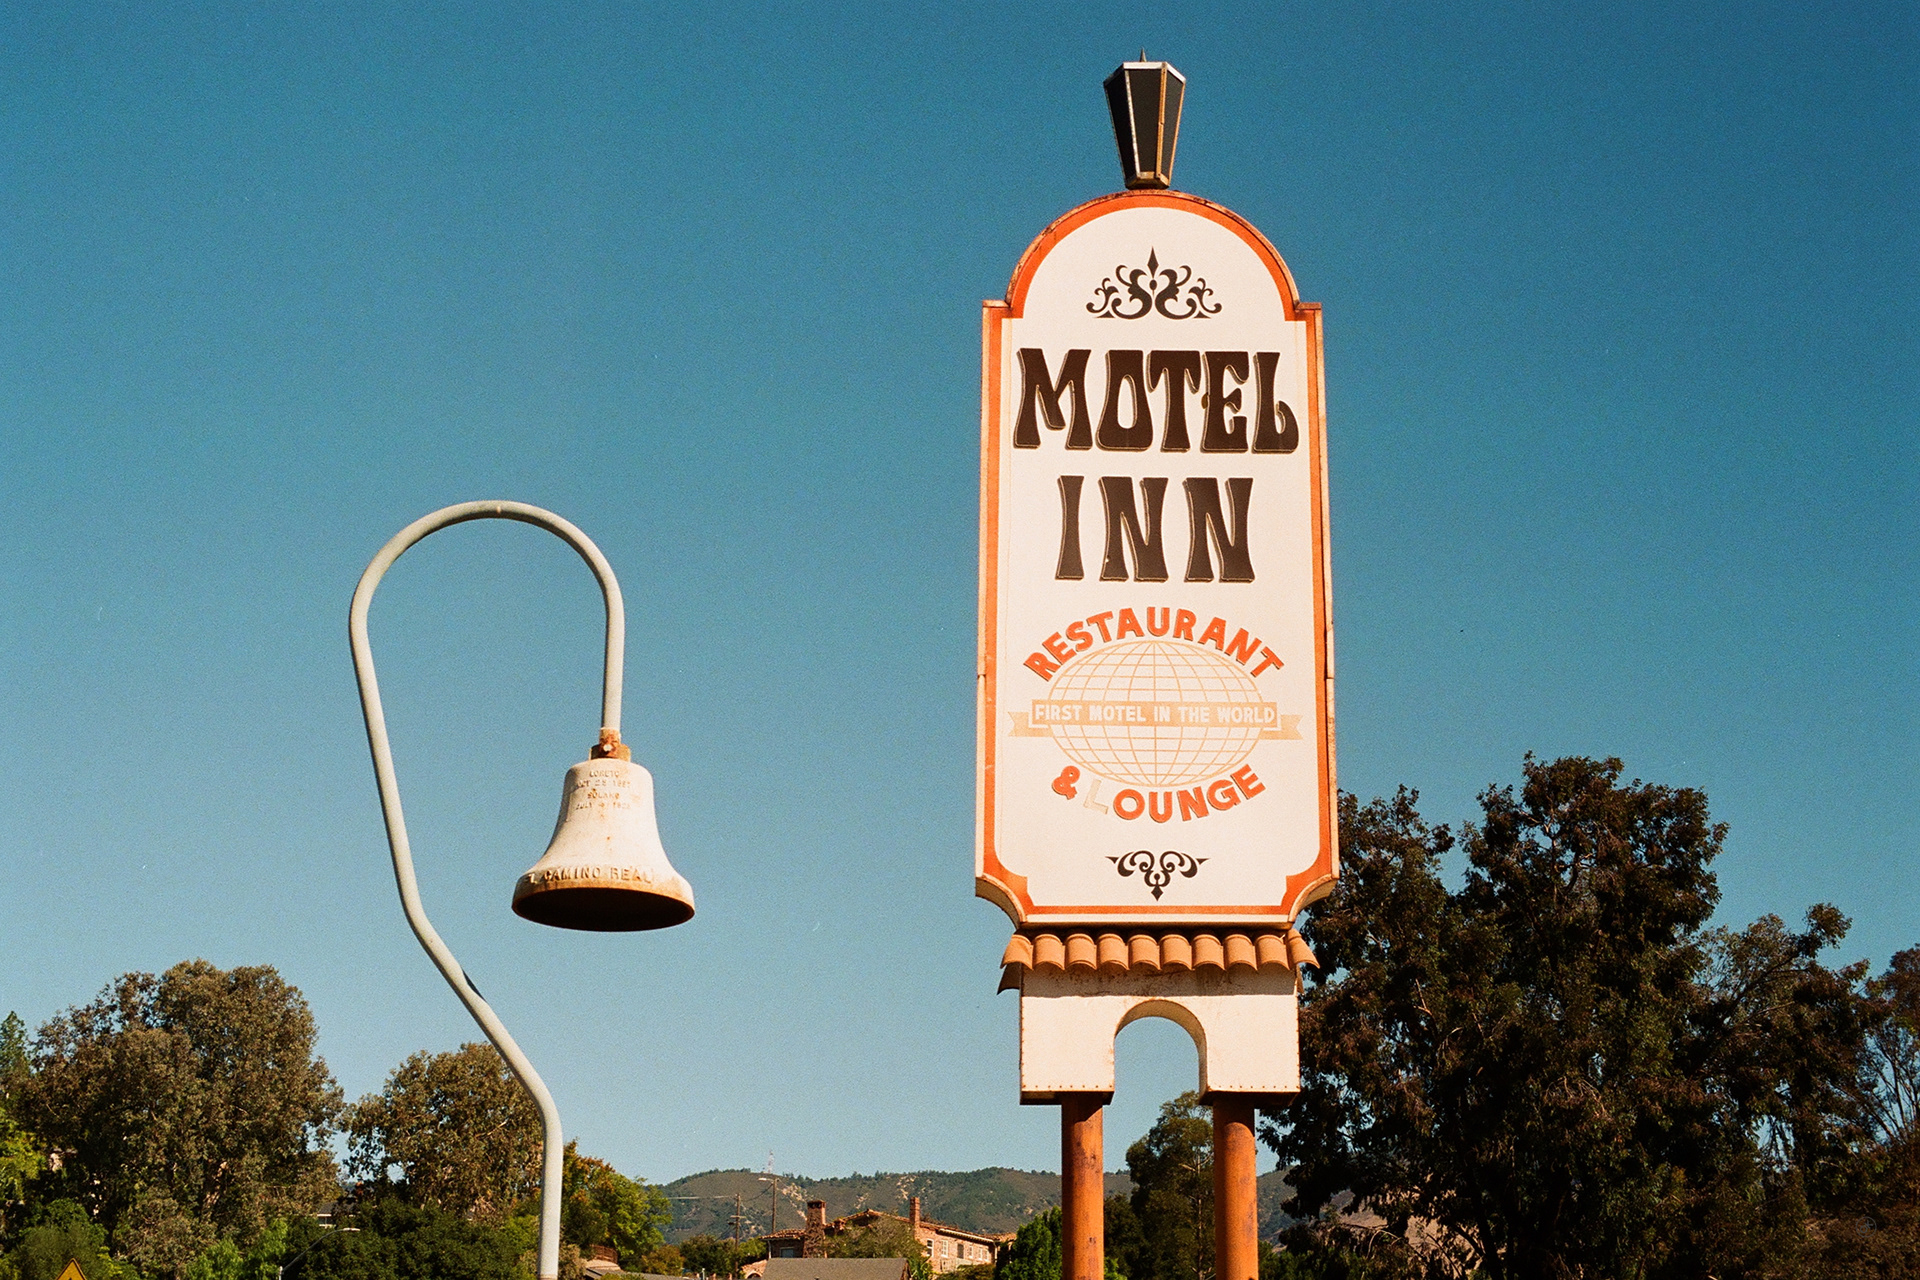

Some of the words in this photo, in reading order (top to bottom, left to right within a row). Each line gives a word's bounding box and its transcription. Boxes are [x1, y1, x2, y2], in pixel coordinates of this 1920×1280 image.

[1013, 348, 1299, 454] MOTEL
[1055, 475, 1256, 583] INN
[1023, 606, 1284, 682] RESTAURANT
[1035, 704, 1083, 721] FIRST
[1089, 705, 1147, 722] MOTEL
[1154, 705, 1171, 722] IN
[1178, 706, 1210, 723] THE
[1217, 706, 1275, 724] WORLD
[1051, 765, 1081, 800] &
[1083, 764, 1266, 823] LOUNGE
[543, 866, 601, 881] CAMINO
[610, 867, 653, 884] REAL
